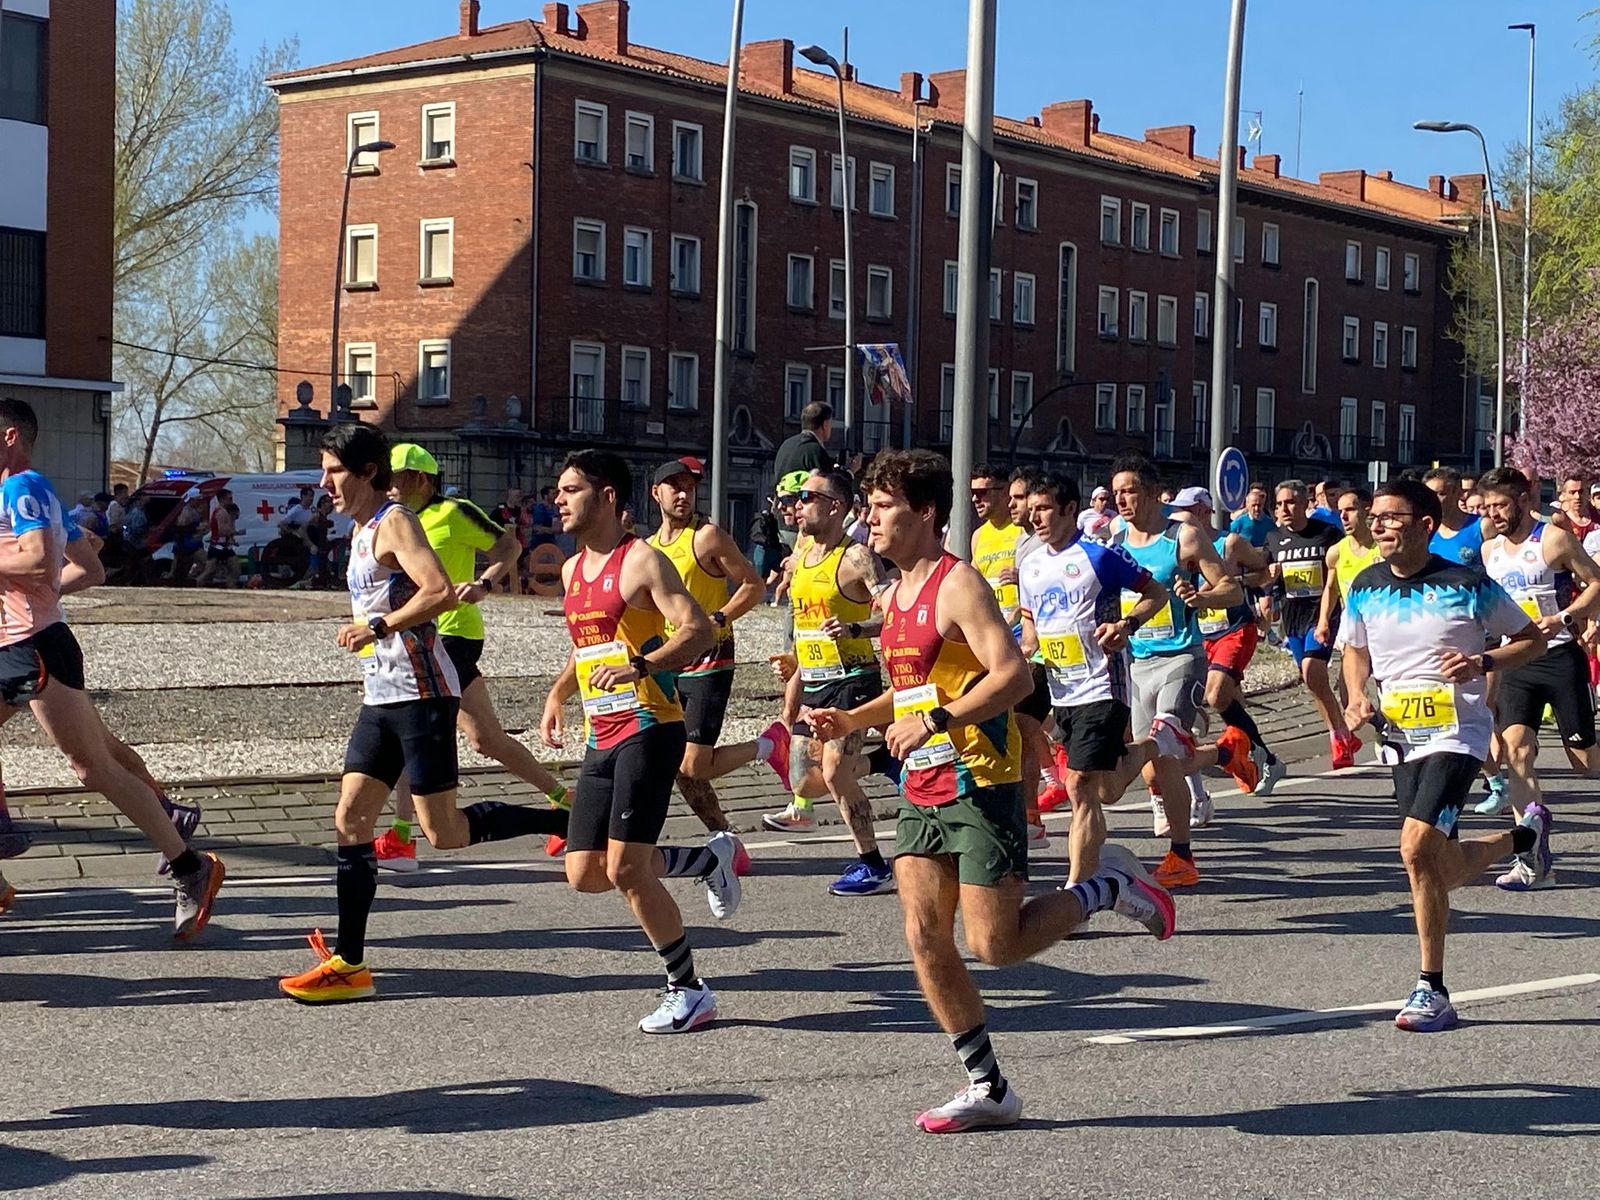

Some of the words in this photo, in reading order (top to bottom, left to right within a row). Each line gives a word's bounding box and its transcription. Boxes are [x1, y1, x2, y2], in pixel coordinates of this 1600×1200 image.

[579, 625, 600, 636] VINO
[588, 633, 611, 646] TORO
[807, 643, 823, 661] 39
[893, 662, 913, 675] VINO
[901, 674, 924, 686] TORO
[1400, 696, 1436, 719] 276
